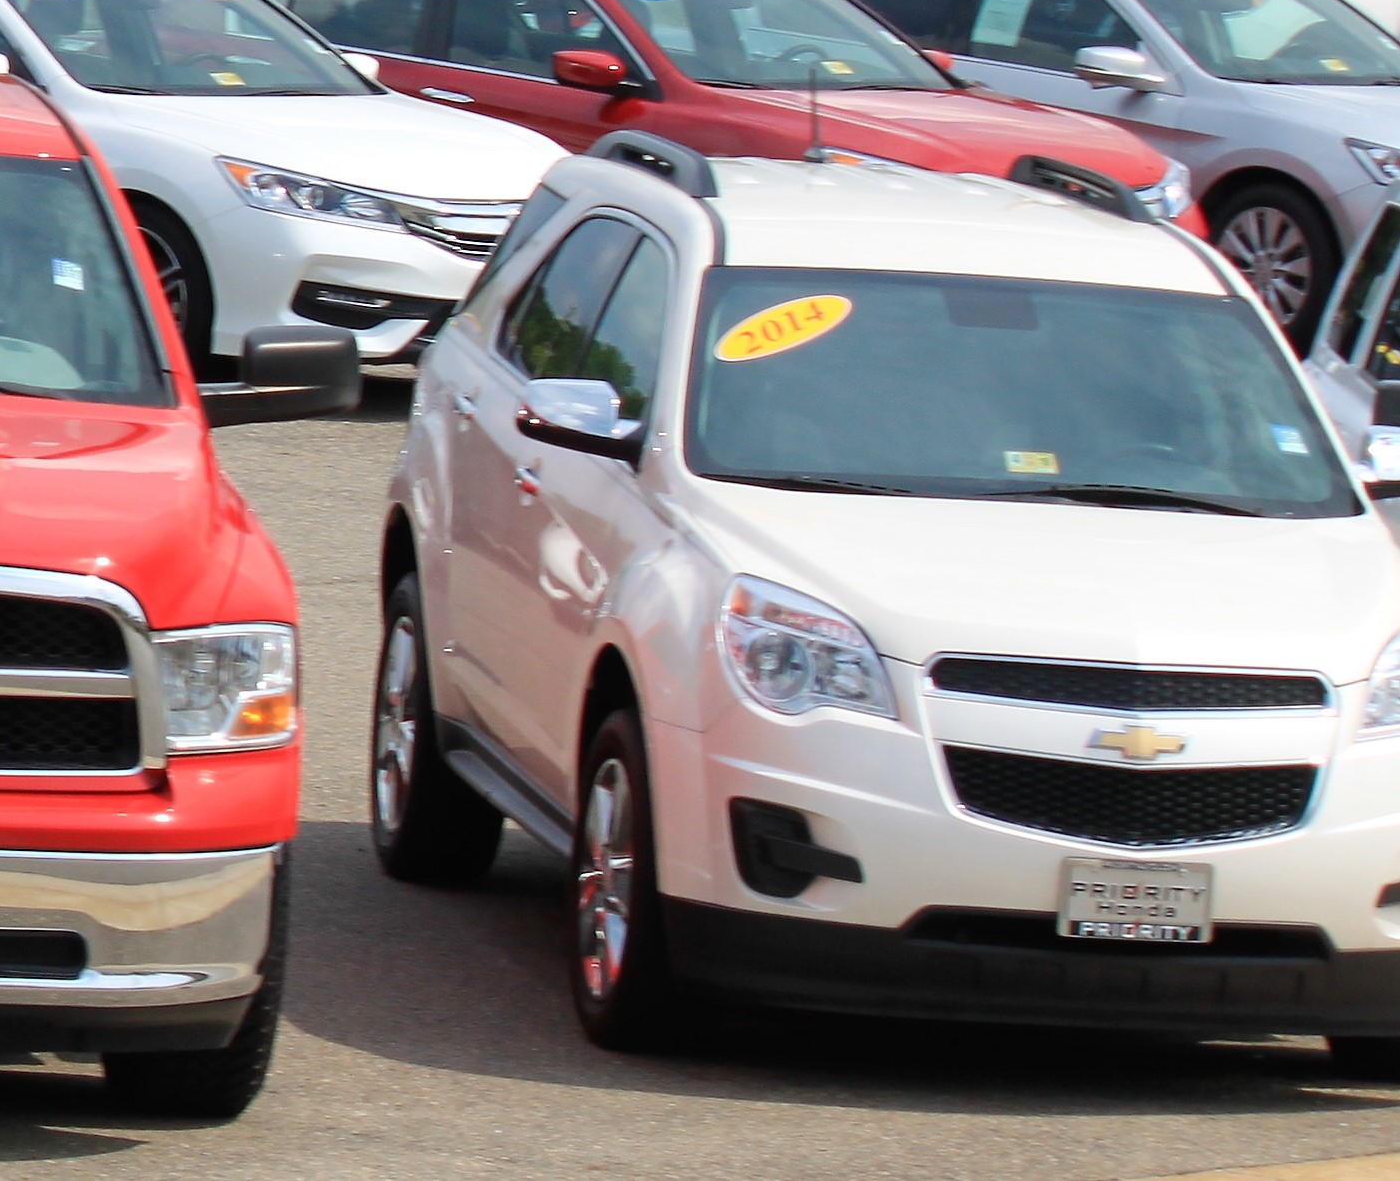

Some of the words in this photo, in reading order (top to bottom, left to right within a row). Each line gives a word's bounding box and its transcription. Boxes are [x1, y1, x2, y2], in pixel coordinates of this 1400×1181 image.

[737, 301, 825, 354] 2014
[1071, 881, 1206, 902] PRIORITY
[1078, 921, 1194, 941] PRIORITY
